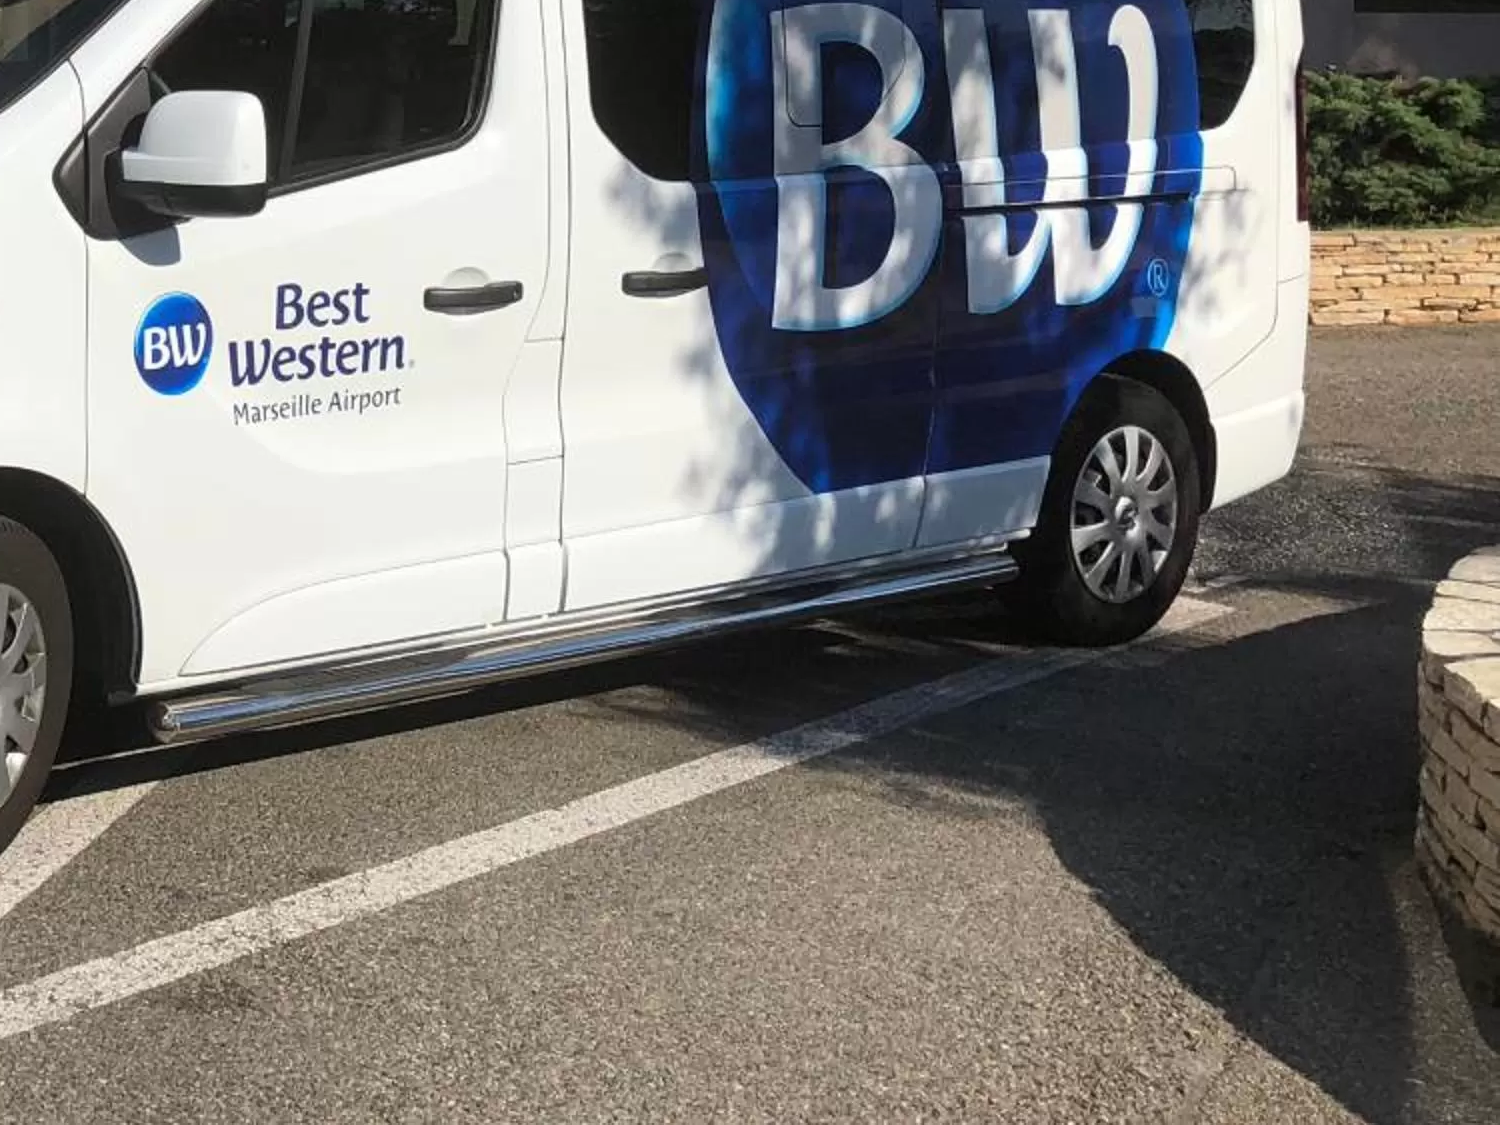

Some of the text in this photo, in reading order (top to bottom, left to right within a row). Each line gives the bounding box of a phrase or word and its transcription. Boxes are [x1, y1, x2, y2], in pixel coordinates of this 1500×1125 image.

[770, 2, 1159, 331] BW
[275, 282, 370, 330] Best
[143, 323, 206, 370] BW
[228, 335, 404, 387] Western
[233, 386, 402, 426] Marseille Airport
